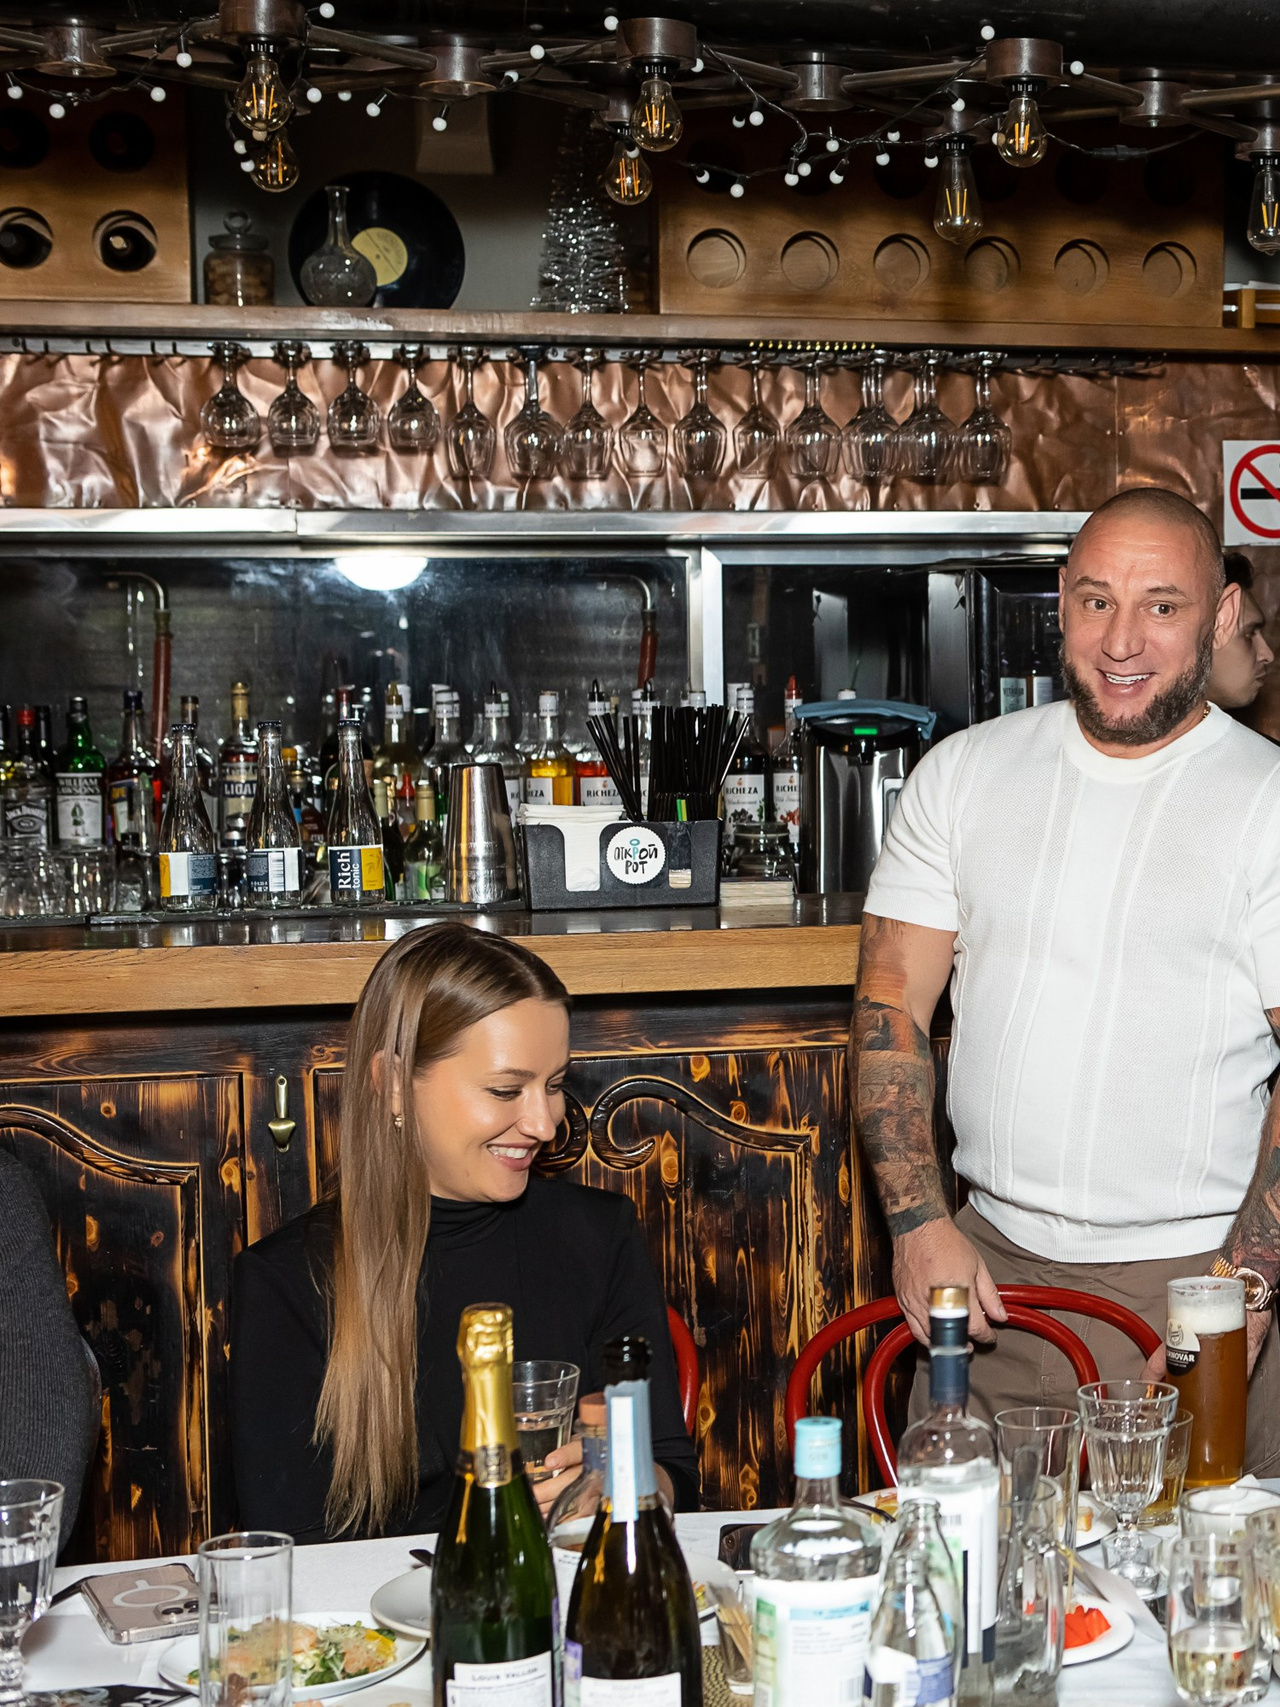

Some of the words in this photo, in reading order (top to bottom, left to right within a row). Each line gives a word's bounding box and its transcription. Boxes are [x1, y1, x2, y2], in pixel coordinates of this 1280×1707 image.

[776, 785, 799, 793] RICHE
[613, 843, 658, 861] ОТКРОЙ
[338, 851, 352, 890] Rich
[350, 863, 361, 889] tonic
[625, 860, 648, 875] РОТ
